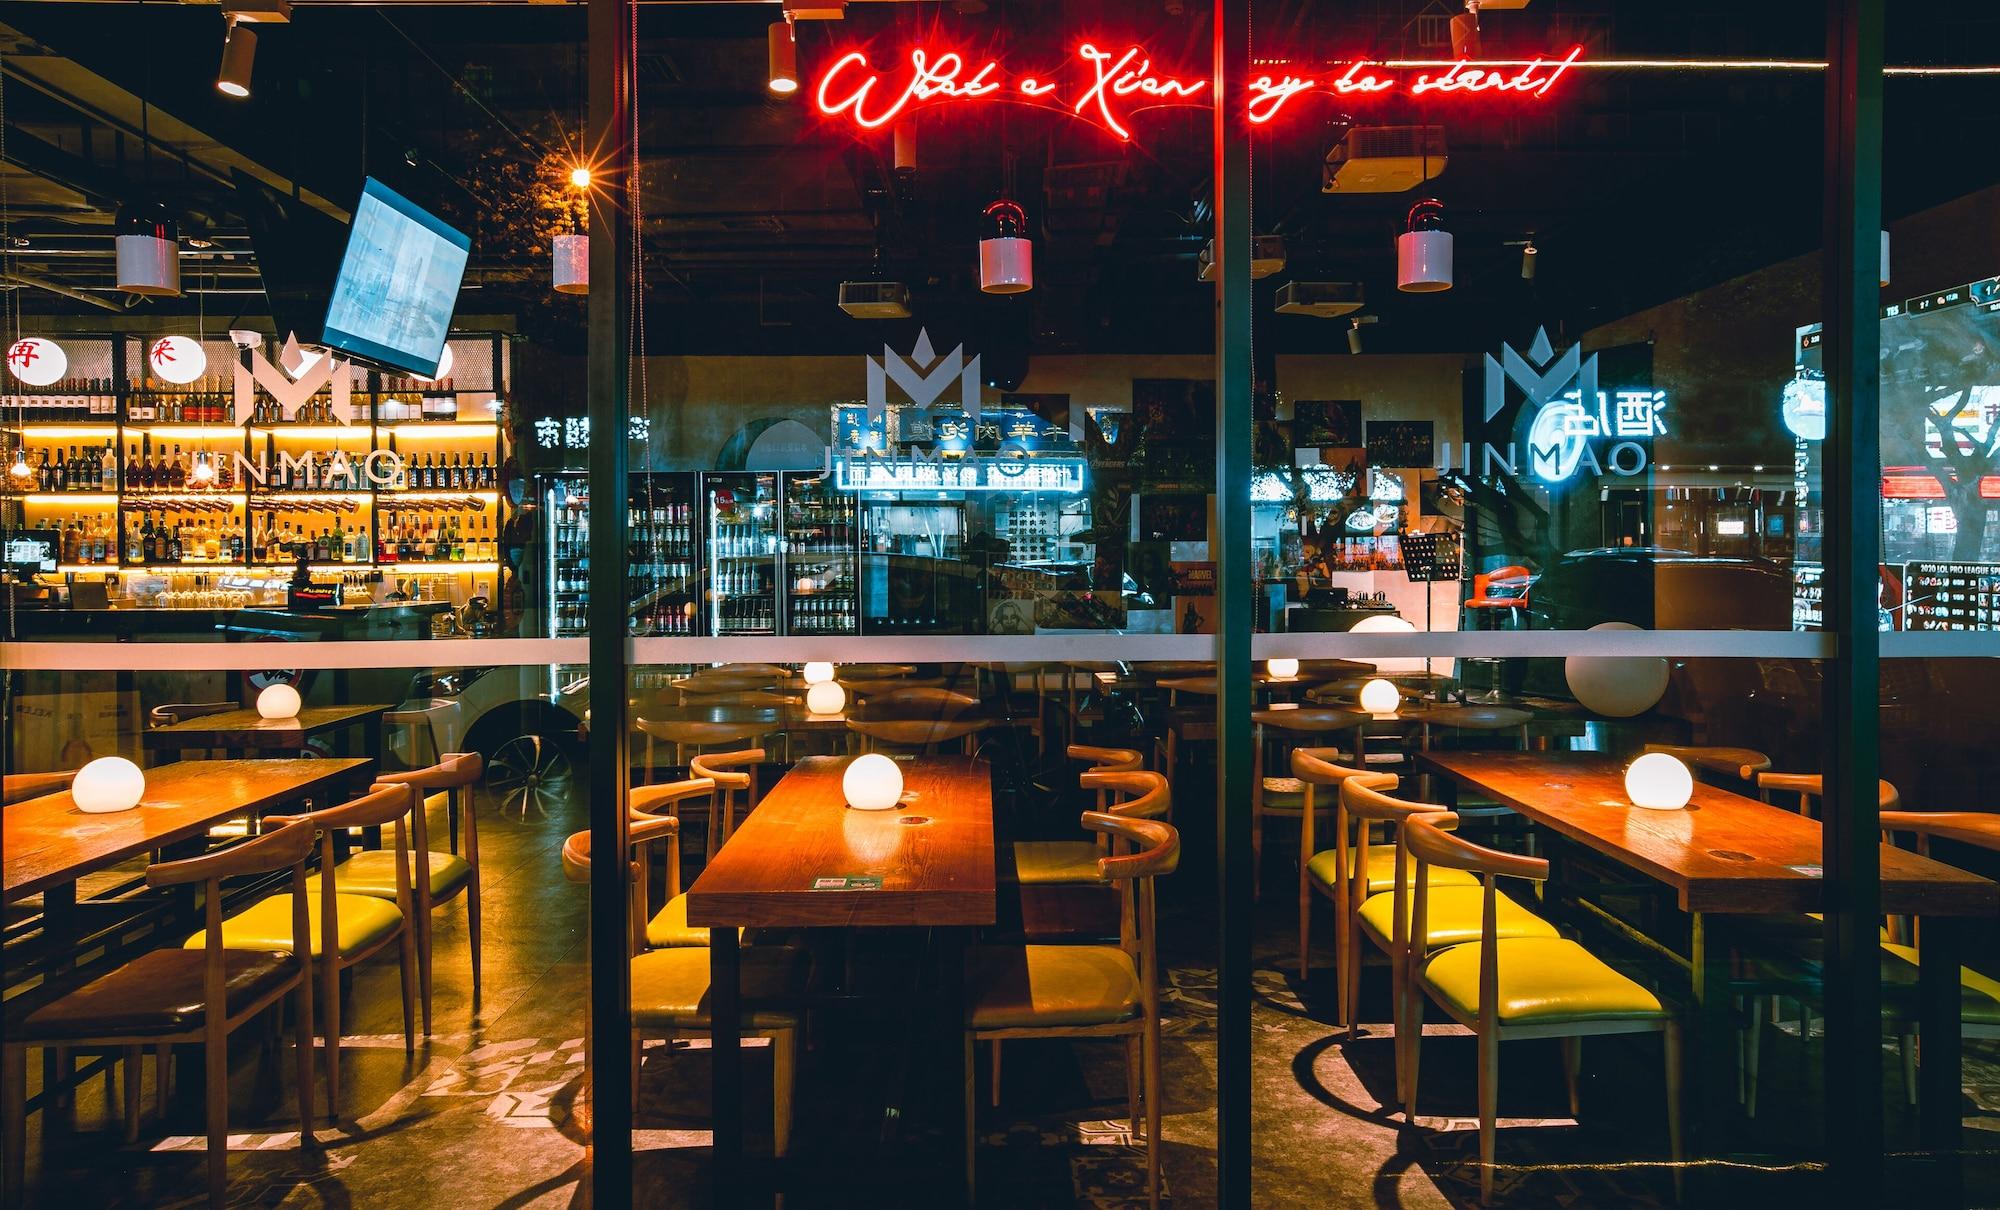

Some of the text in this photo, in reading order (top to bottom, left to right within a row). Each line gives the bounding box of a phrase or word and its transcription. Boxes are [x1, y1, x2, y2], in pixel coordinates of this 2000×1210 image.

[818, 49, 1000, 127] What
[1021, 77, 1055, 95] a
[1335, 61, 1394, 92] to
[1886, 305, 1899, 317] TES
[7, 341, 40, 368] 再
[152, 339, 176, 366] 来
[186, 449, 402, 485] JINMAO
[818, 444, 1030, 480] JINMAO
[1436, 442, 1647, 477] JINMAO
[1950, 566, 1963, 574] PRO
[1964, 567, 1988, 575] LEAGUE
